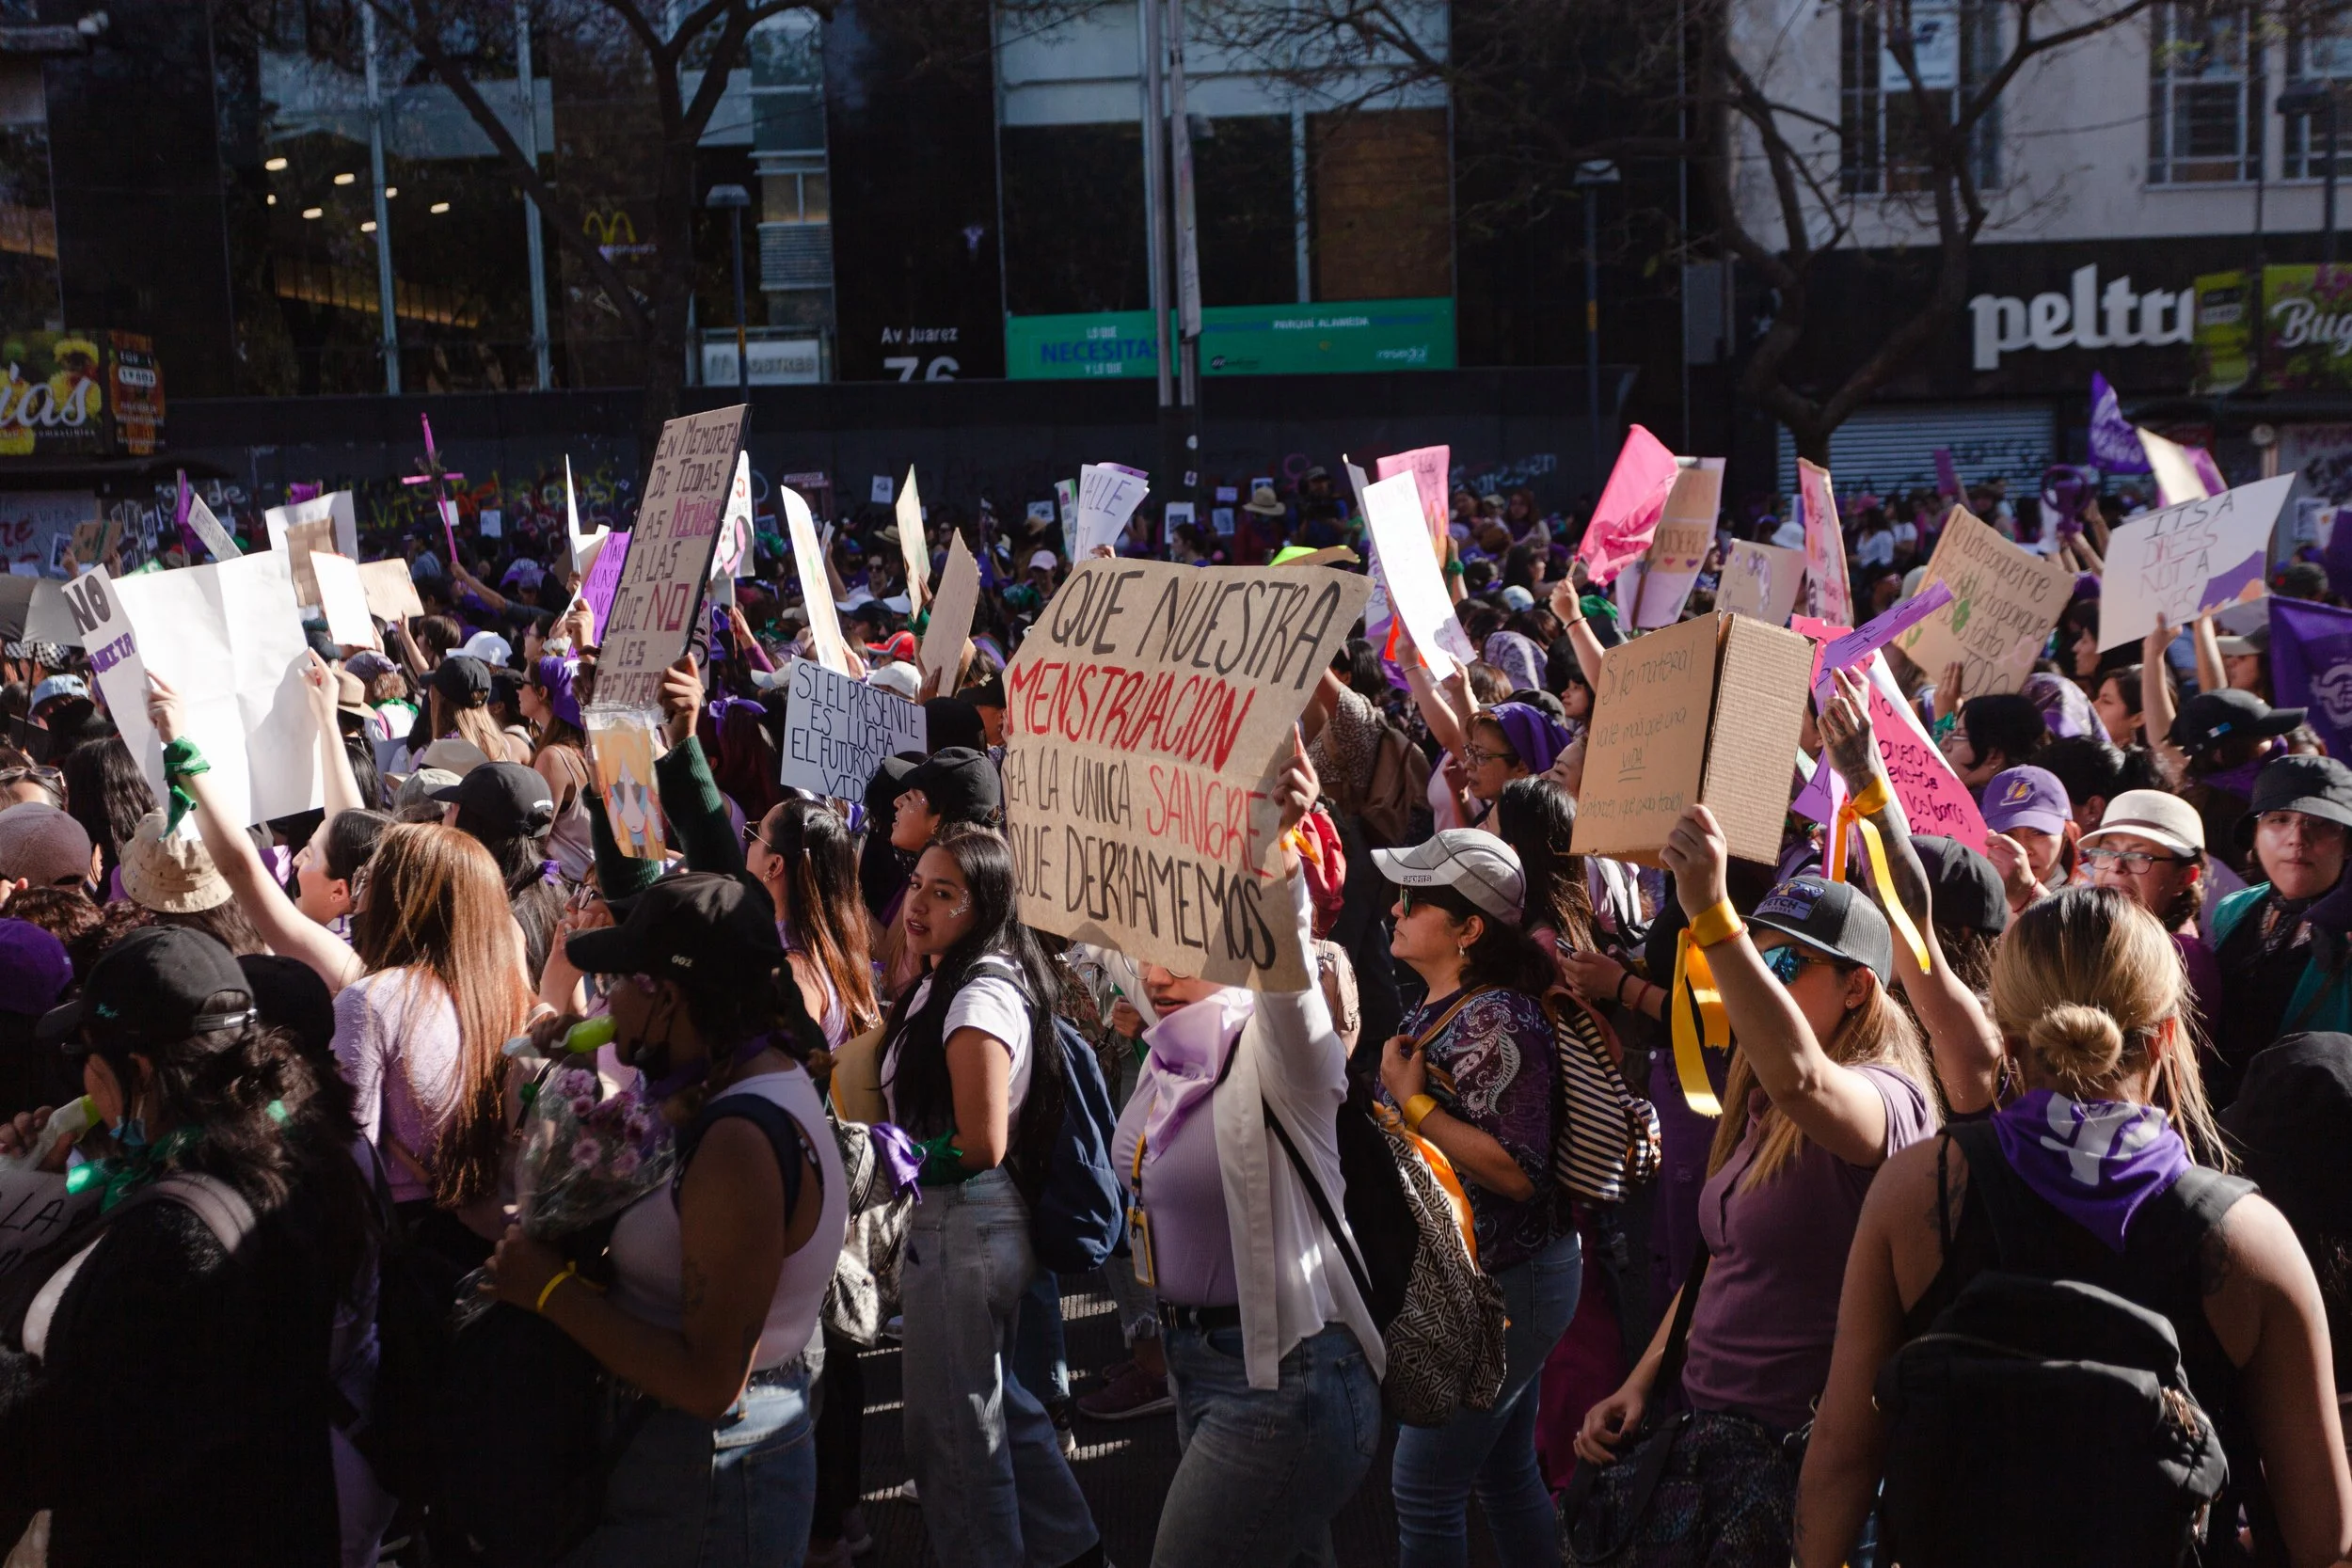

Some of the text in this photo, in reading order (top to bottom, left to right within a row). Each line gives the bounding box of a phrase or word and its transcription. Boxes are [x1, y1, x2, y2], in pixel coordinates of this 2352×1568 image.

[882, 327, 958, 344] Av Juarez
[656, 417, 739, 461] EN MEMORIA
[649, 457, 723, 499] DE TODAS
[634, 506, 668, 543] LAS
[668, 495, 721, 539] NIÑAS
[630, 548, 644, 584] A
[646, 541, 682, 581] LAS
[63, 574, 111, 636] NO
[610, 580, 691, 633] QUE NO
[1051, 569, 1342, 689] QUE NUESTRA
[618, 636, 647, 668] LES
[796, 663, 919, 739] SI EL PRESENTE
[1009, 657, 1256, 773] MENSTRUACION
[792, 727, 875, 781] EL FUTURO
[811, 704, 896, 756] ES LUCHA
[1039, 746, 1060, 815] LA
[1073, 754, 1133, 832] UNICA
[1146, 764, 1274, 879] SANGRE
[1009, 822, 1277, 971] QUE DERRAMEMOS
[1403, 875, 1432, 884] SPORTS
[671, 954, 693, 969] 002
